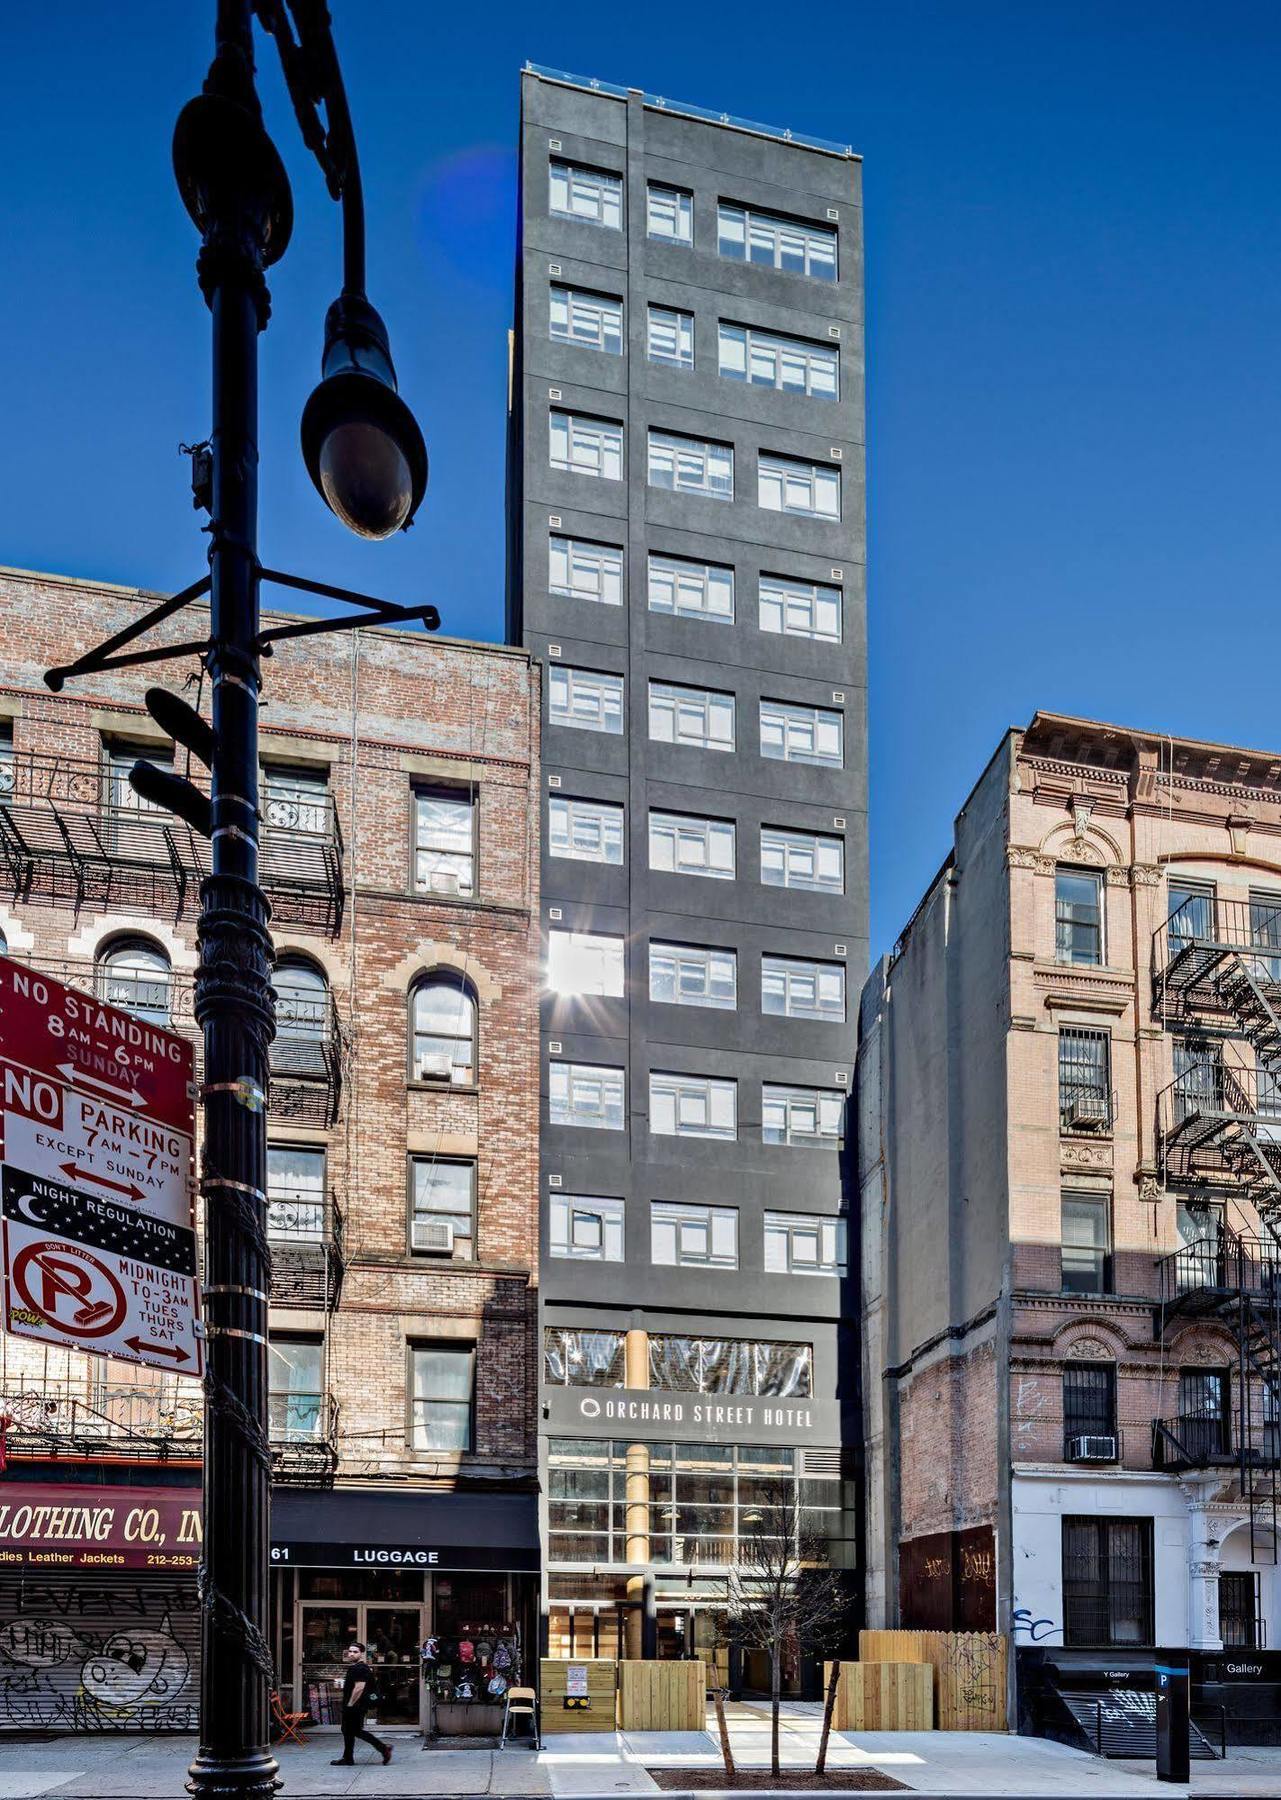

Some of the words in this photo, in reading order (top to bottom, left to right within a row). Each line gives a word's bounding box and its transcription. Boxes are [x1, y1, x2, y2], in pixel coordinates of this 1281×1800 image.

[13, 972, 49, 1005] NO
[64, 996, 182, 1064] STANDING
[66, 1044, 141, 1086] SUNDAY
[5, 1068, 60, 1120] NO
[81, 1102, 180, 1158] PARKING
[35, 1133, 95, 1163] EXCEPT
[106, 1160, 165, 1190] SUNDAY
[32, 1181, 79, 1206] NIGHT
[86, 1202, 176, 1240] REGULATION
[70, 1247, 96, 1263] LITTER
[119, 1259, 187, 1292] MIDNIGHT
[144, 1301, 178, 1318] TUES
[139, 1311, 185, 1331] THURS
[150, 1326, 175, 1341] SAT
[606, 1401, 683, 1421] ORCHARD
[693, 1406, 754, 1424] STREET
[764, 1409, 813, 1427] HOTEL
[0, 1505, 115, 1541] LOTHING
[124, 1508, 166, 1546] CO.,
[28, 1551, 74, 1562] Leather
[80, 1552, 125, 1564] Jackets
[354, 1550, 439, 1563] LUGGAGE
[1110, 1671, 1130, 1679] Gallery
[1227, 1663, 1263, 1676] Gallery
[1160, 1674, 1167, 1686] P
